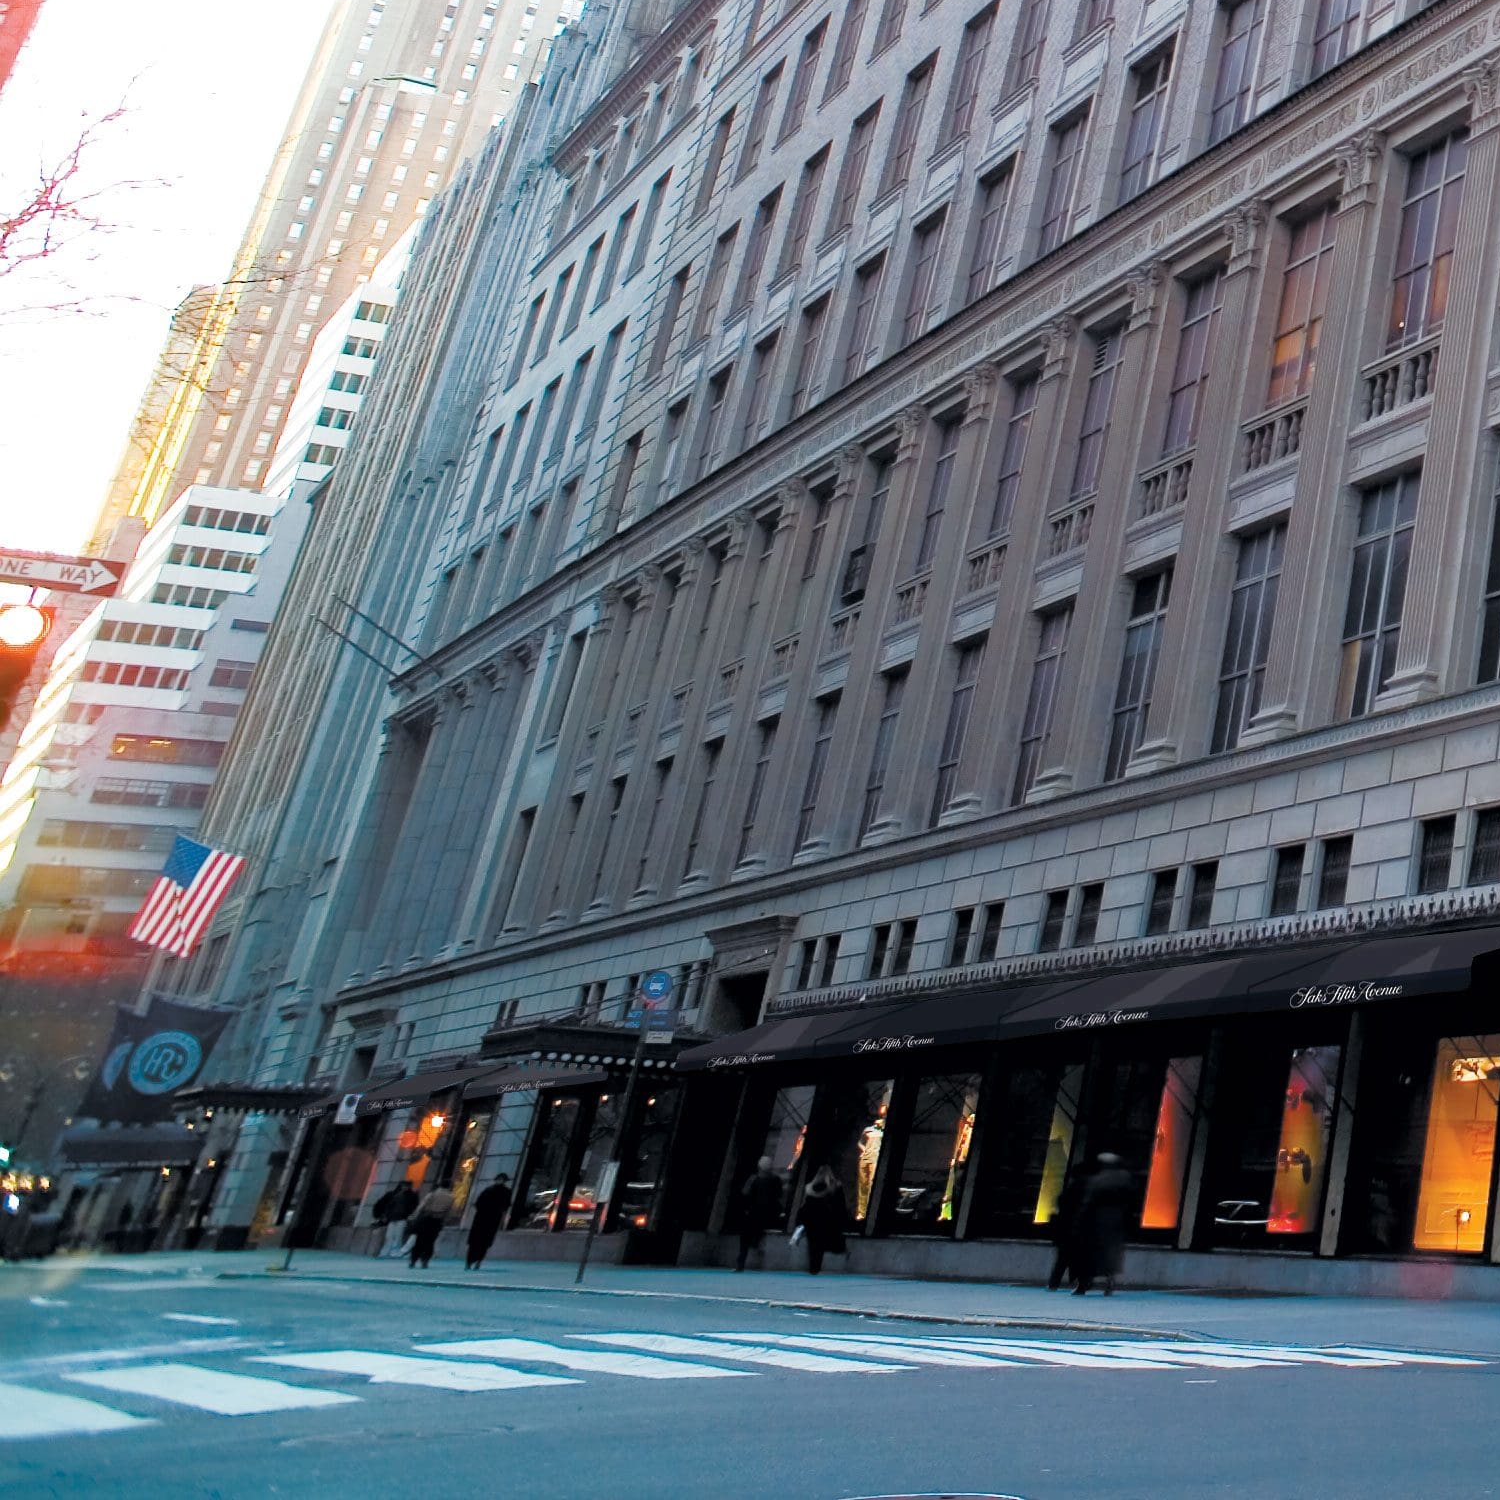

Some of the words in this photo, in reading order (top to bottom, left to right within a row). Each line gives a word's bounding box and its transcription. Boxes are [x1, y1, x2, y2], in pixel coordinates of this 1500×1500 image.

[0, 558, 33, 575] NE
[60, 566, 104, 583] WAY
[1290, 985, 1327, 1008] Saks
[1322, 984, 1356, 1004] Fifth
[1350, 981, 1402, 1002] Avenue
[1055, 1015, 1082, 1029] Saks
[1080, 1013, 1106, 1027] Fifth
[1104, 1010, 1148, 1024] Avenue
